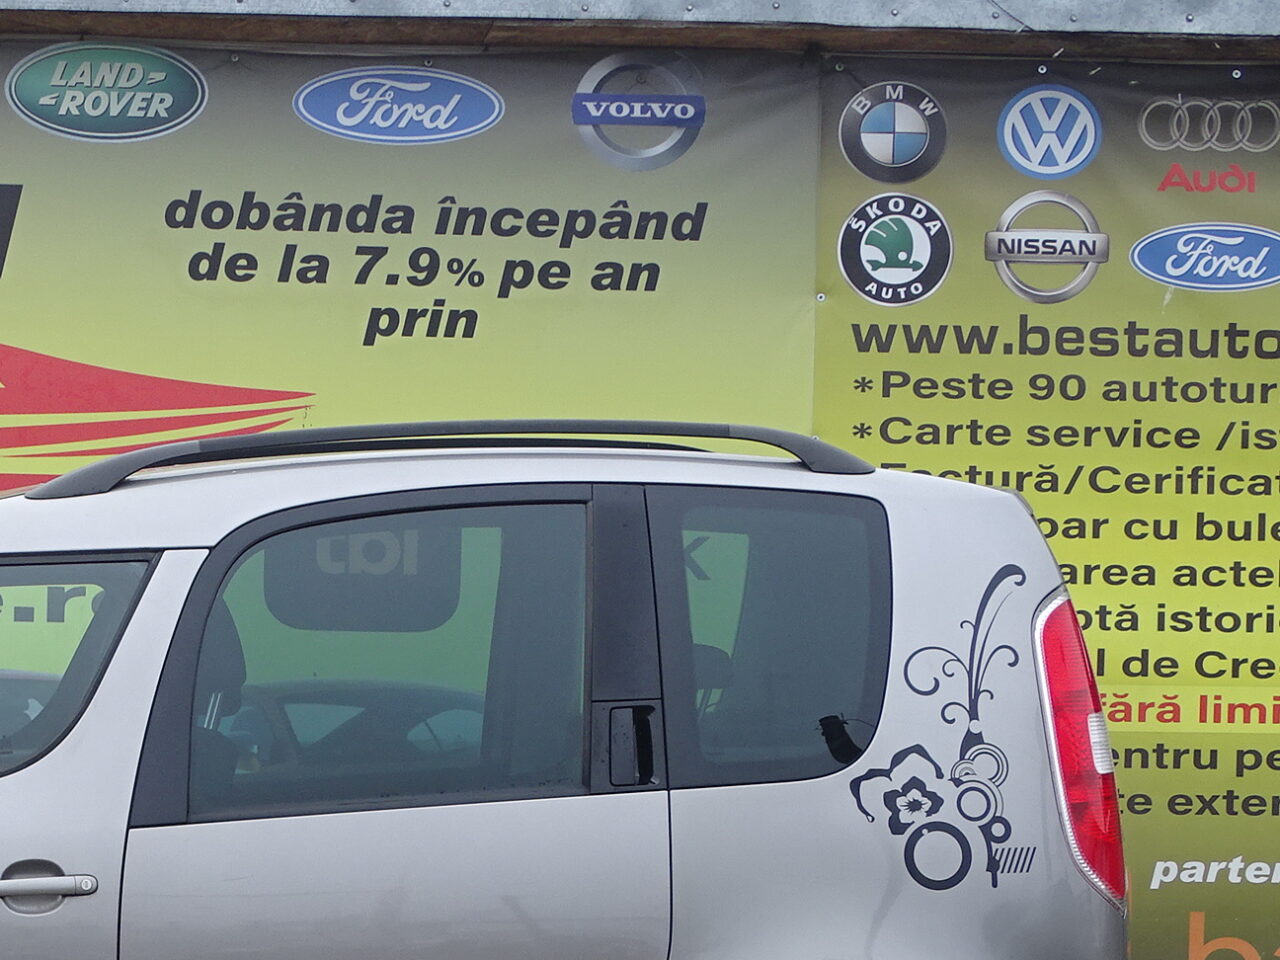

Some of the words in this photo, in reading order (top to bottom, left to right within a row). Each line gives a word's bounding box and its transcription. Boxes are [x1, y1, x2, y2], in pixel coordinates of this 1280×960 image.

[335, 77, 460, 132] Ford
[581, 100, 696, 120] VOLVO
[851, 85, 940, 117] BMW
[164, 190, 416, 236] dobânda
[433, 194, 709, 249] începând
[996, 237, 1097, 257] NISSAN
[1164, 232, 1271, 279] Ford
[187, 243, 260, 284] de
[277, 244, 332, 286] la
[351, 245, 485, 289] 7.9%
[496, 256, 573, 299] pe
[589, 258, 662, 293] an
[865, 281, 924, 300] AUTO
[361, 298, 481, 346] prin
[851, 313, 1280, 360] www.bestauto
[1028, 373, 1087, 401] 90
[1102, 376, 1279, 404] autotur
[1026, 416, 1201, 450] service
[1214, 420, 1280, 453] /is
[1123, 517, 1179, 541] cu
[1172, 560, 1280, 588] acte
[1156, 602, 1280, 634] istori
[1121, 648, 1180, 678] de
[1194, 650, 1280, 680] Cre
